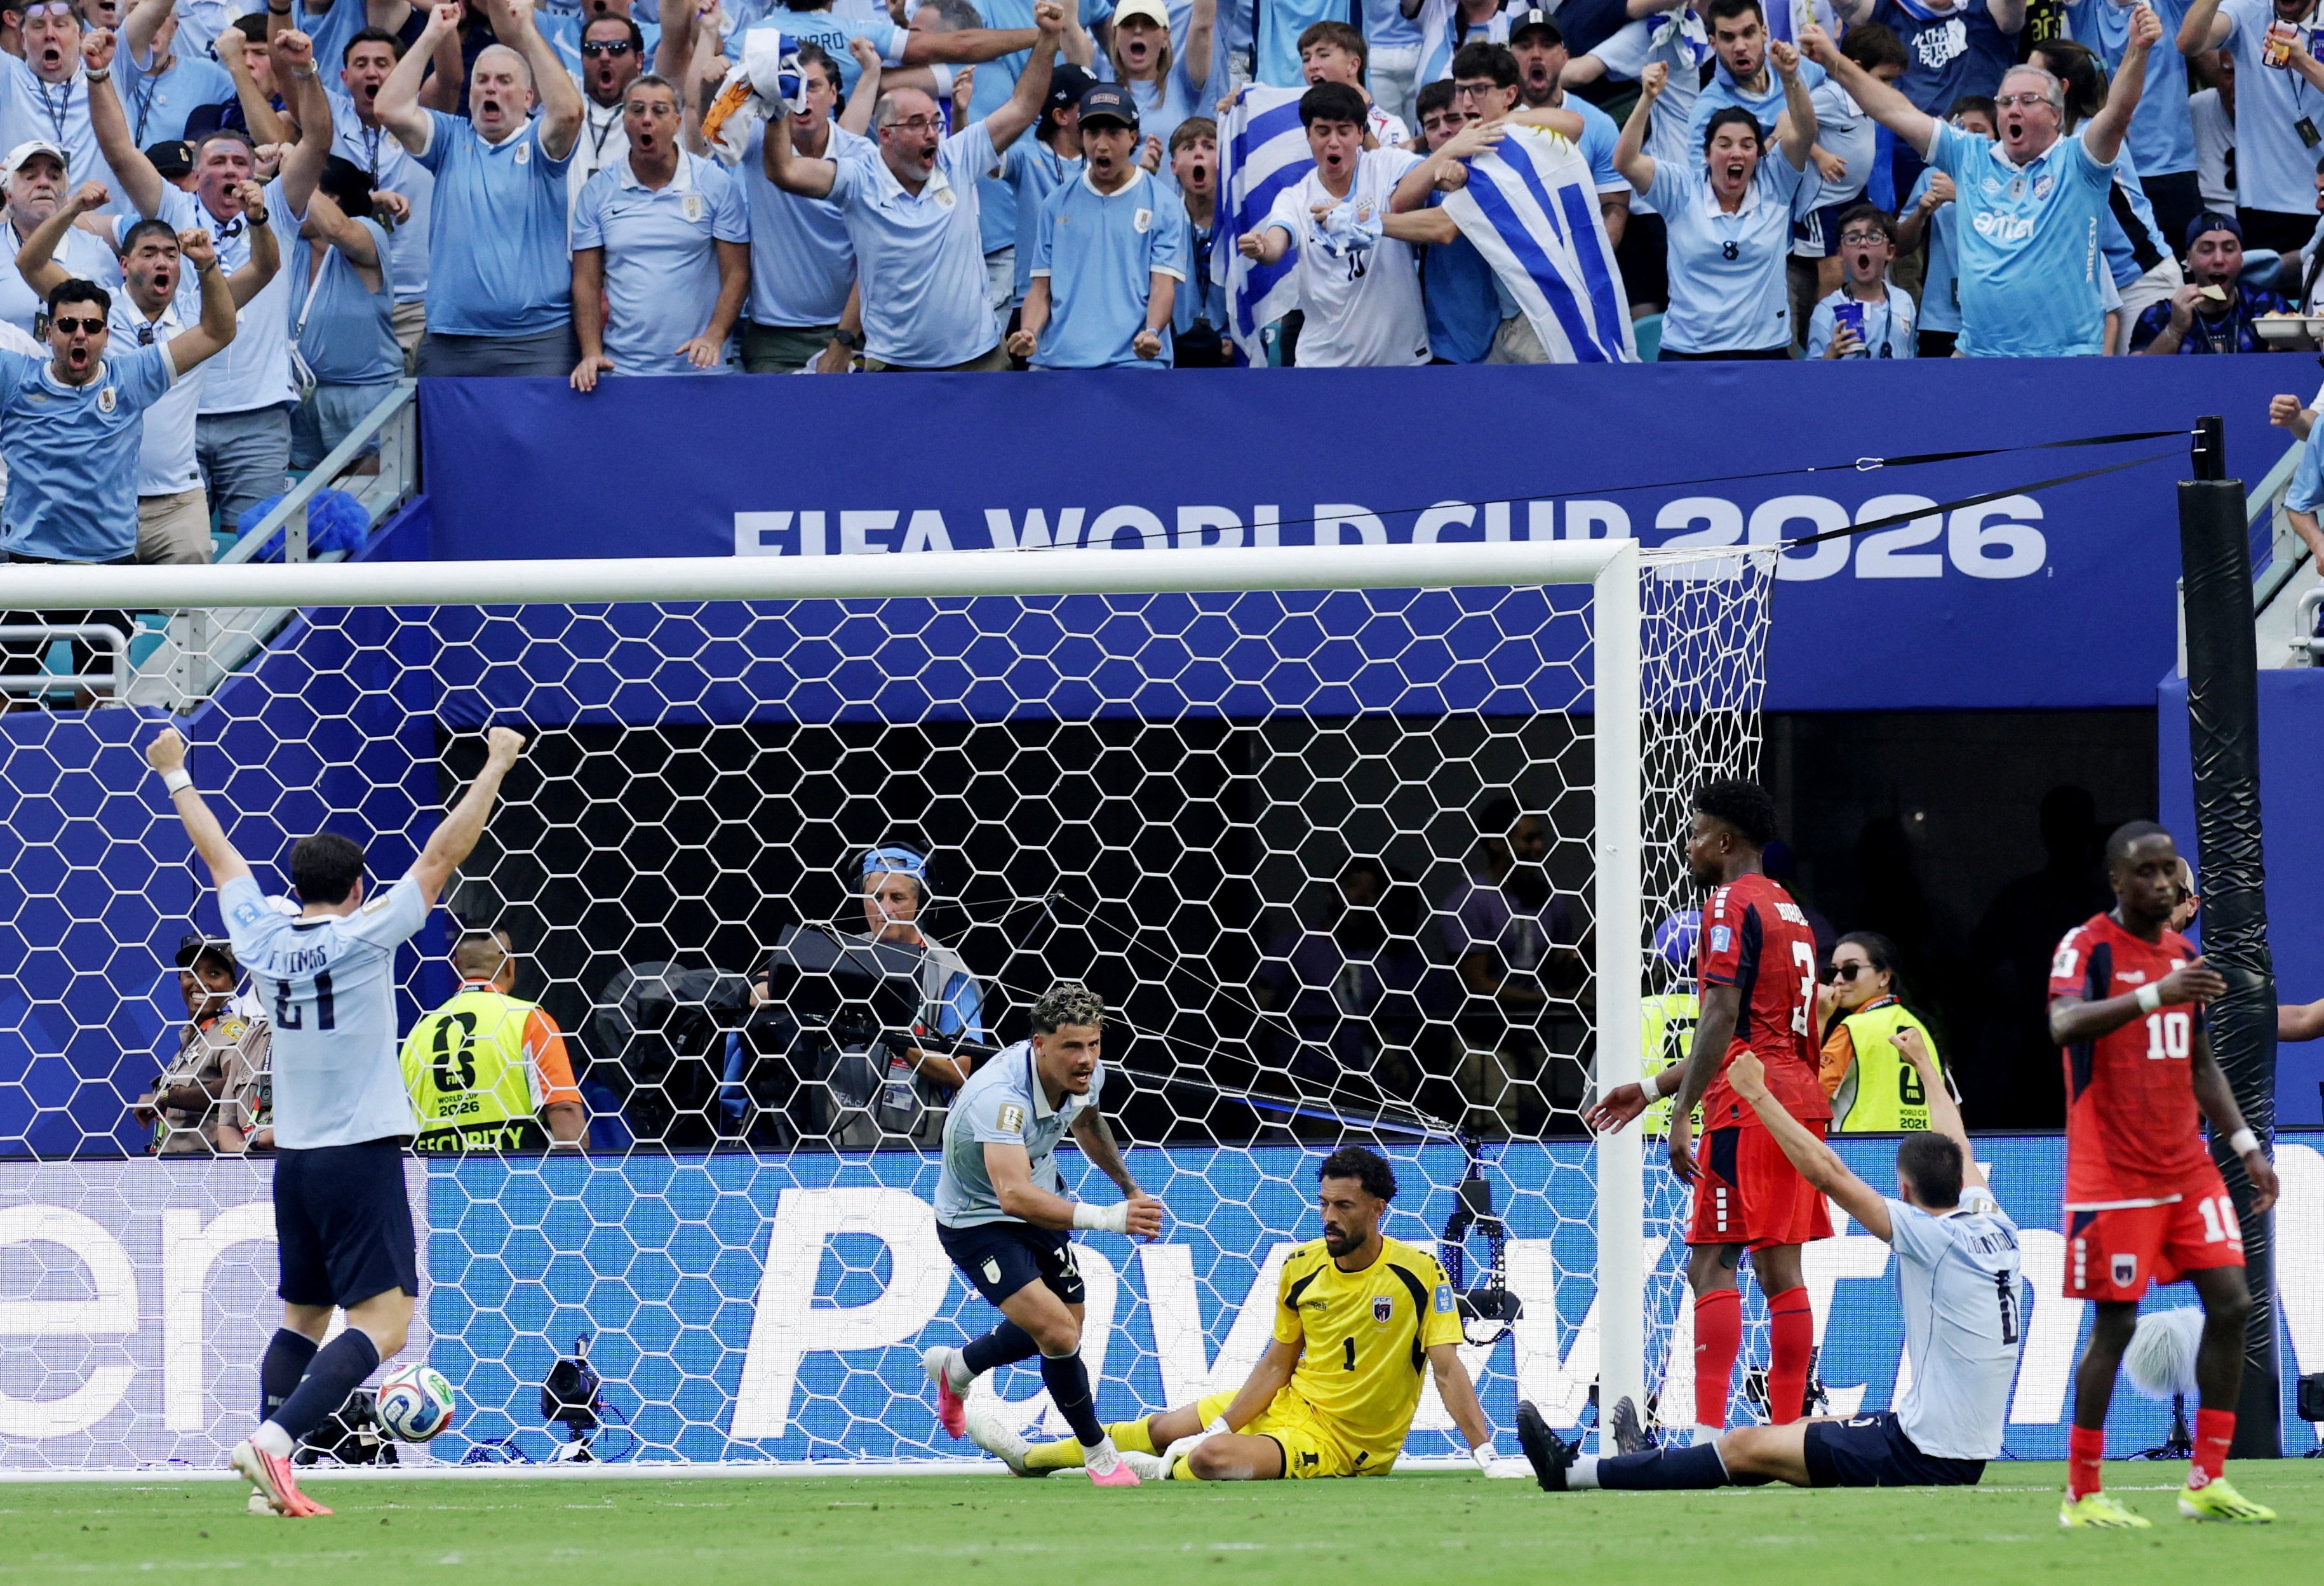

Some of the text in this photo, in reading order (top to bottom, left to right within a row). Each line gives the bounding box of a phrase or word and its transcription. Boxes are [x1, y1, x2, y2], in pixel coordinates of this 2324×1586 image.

[1723, 240, 1739, 261] 8
[1655, 494, 2046, 581] 2026
[1792, 941, 1815, 1037] 3
[2146, 1011, 2190, 1059] 10
[438, 1094, 462, 1104] WORLD
[439, 1101, 480, 1117] 2026
[1343, 1336, 1355, 1371] 1
